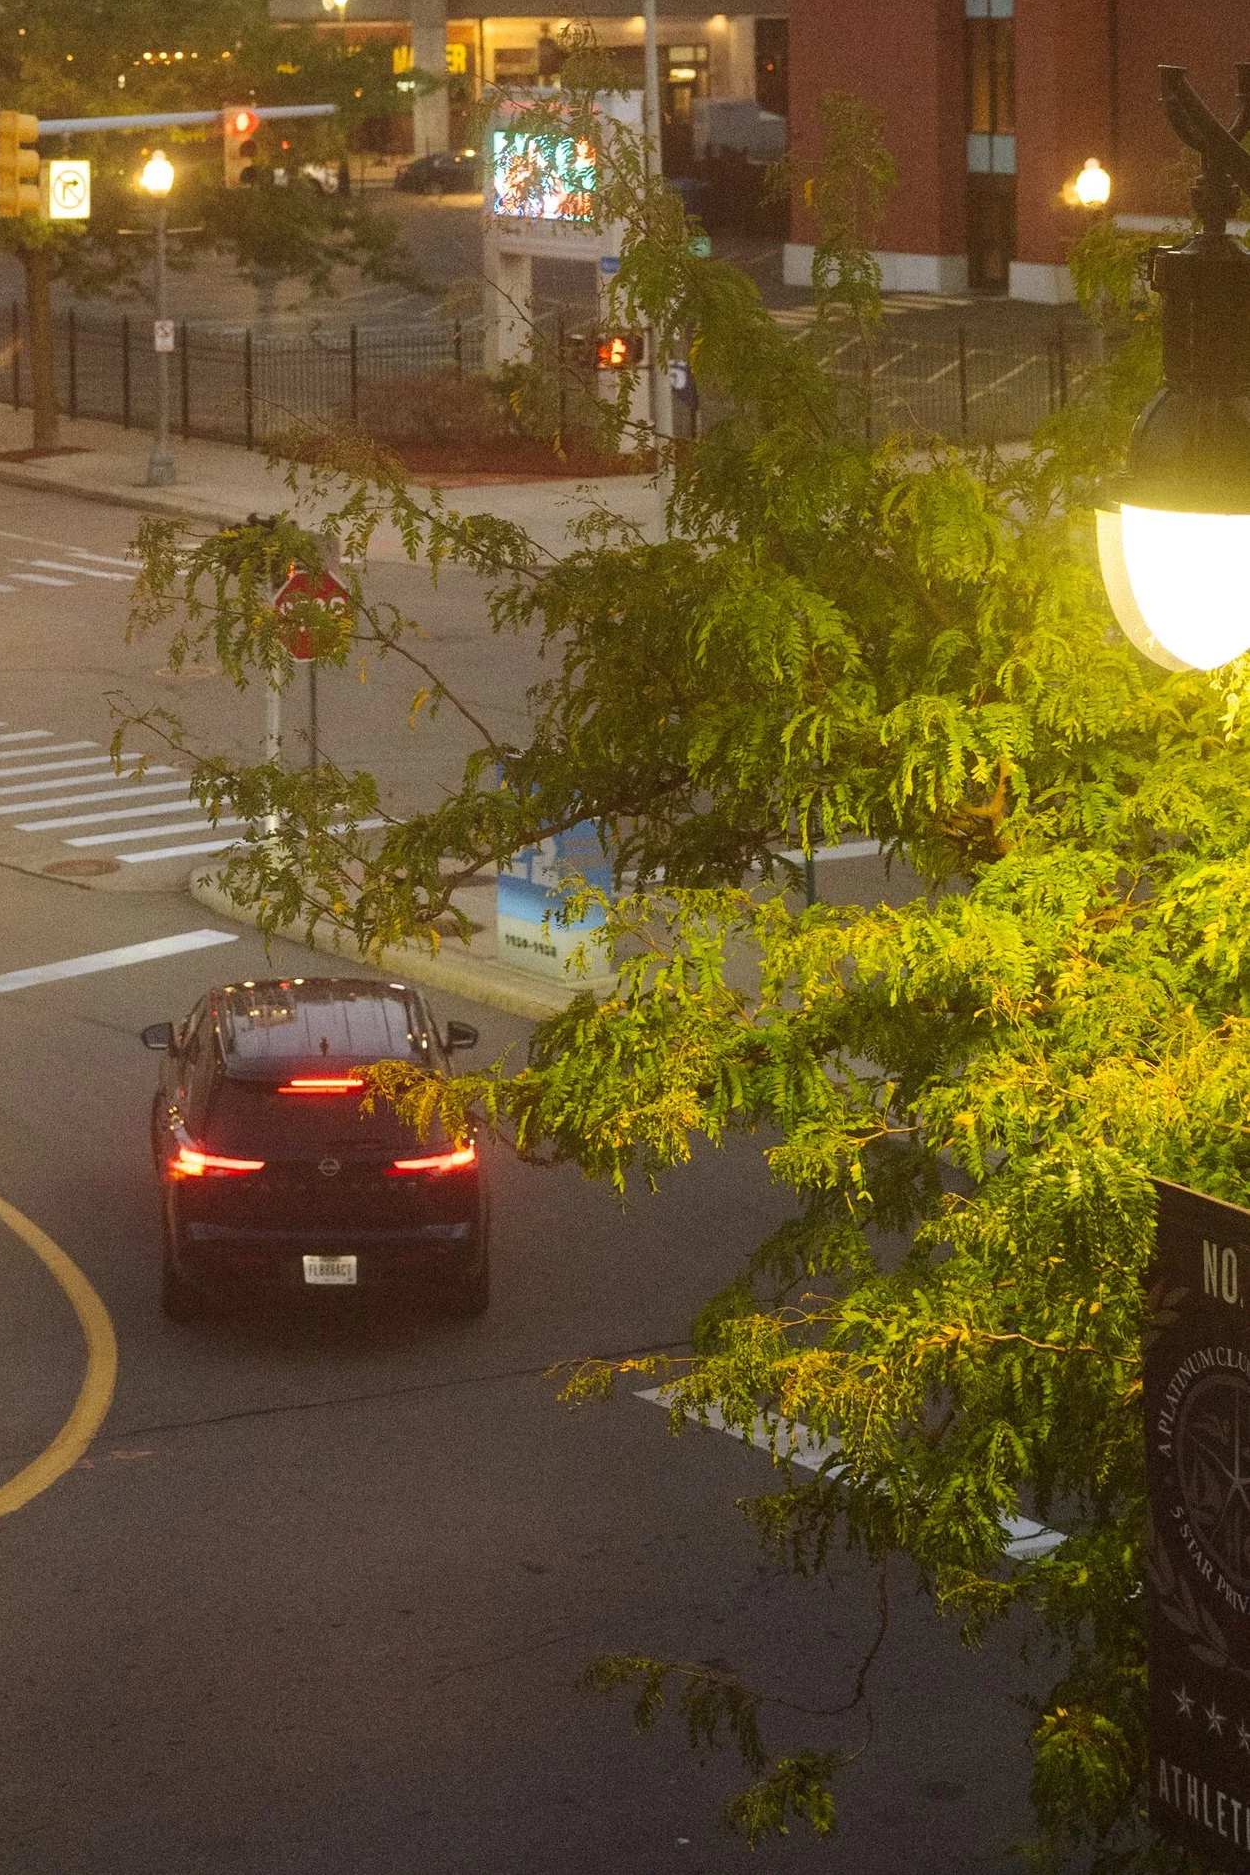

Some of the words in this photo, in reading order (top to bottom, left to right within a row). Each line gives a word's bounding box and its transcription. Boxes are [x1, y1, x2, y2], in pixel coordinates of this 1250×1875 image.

[1203, 1239, 1244, 1308] NO.
[1216, 1346, 1250, 1374] CLU
[1158, 1347, 1215, 1436] PLATINUM
[1158, 1443, 1172, 1458] A
[1180, 1524, 1213, 1582] STAR
